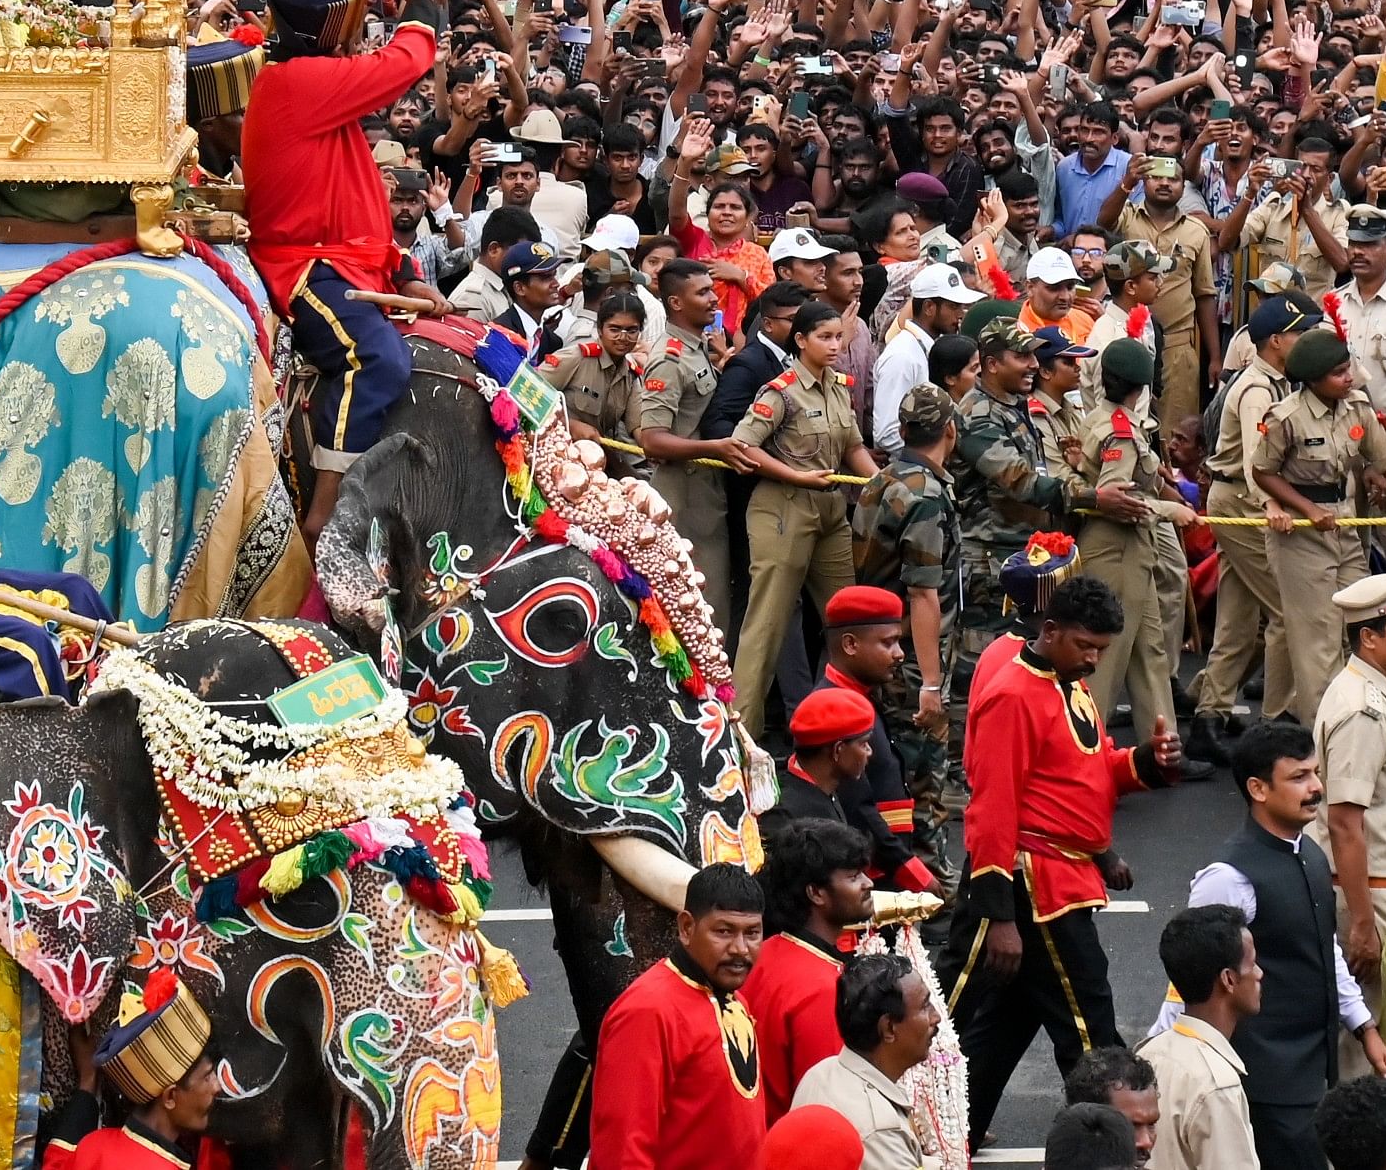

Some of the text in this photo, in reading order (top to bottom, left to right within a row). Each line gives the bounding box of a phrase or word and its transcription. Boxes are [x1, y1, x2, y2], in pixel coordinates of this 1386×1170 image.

[647, 380, 663, 390] NCC
[754, 404, 771, 416] NCC
[1102, 451, 1120, 460] NCC
